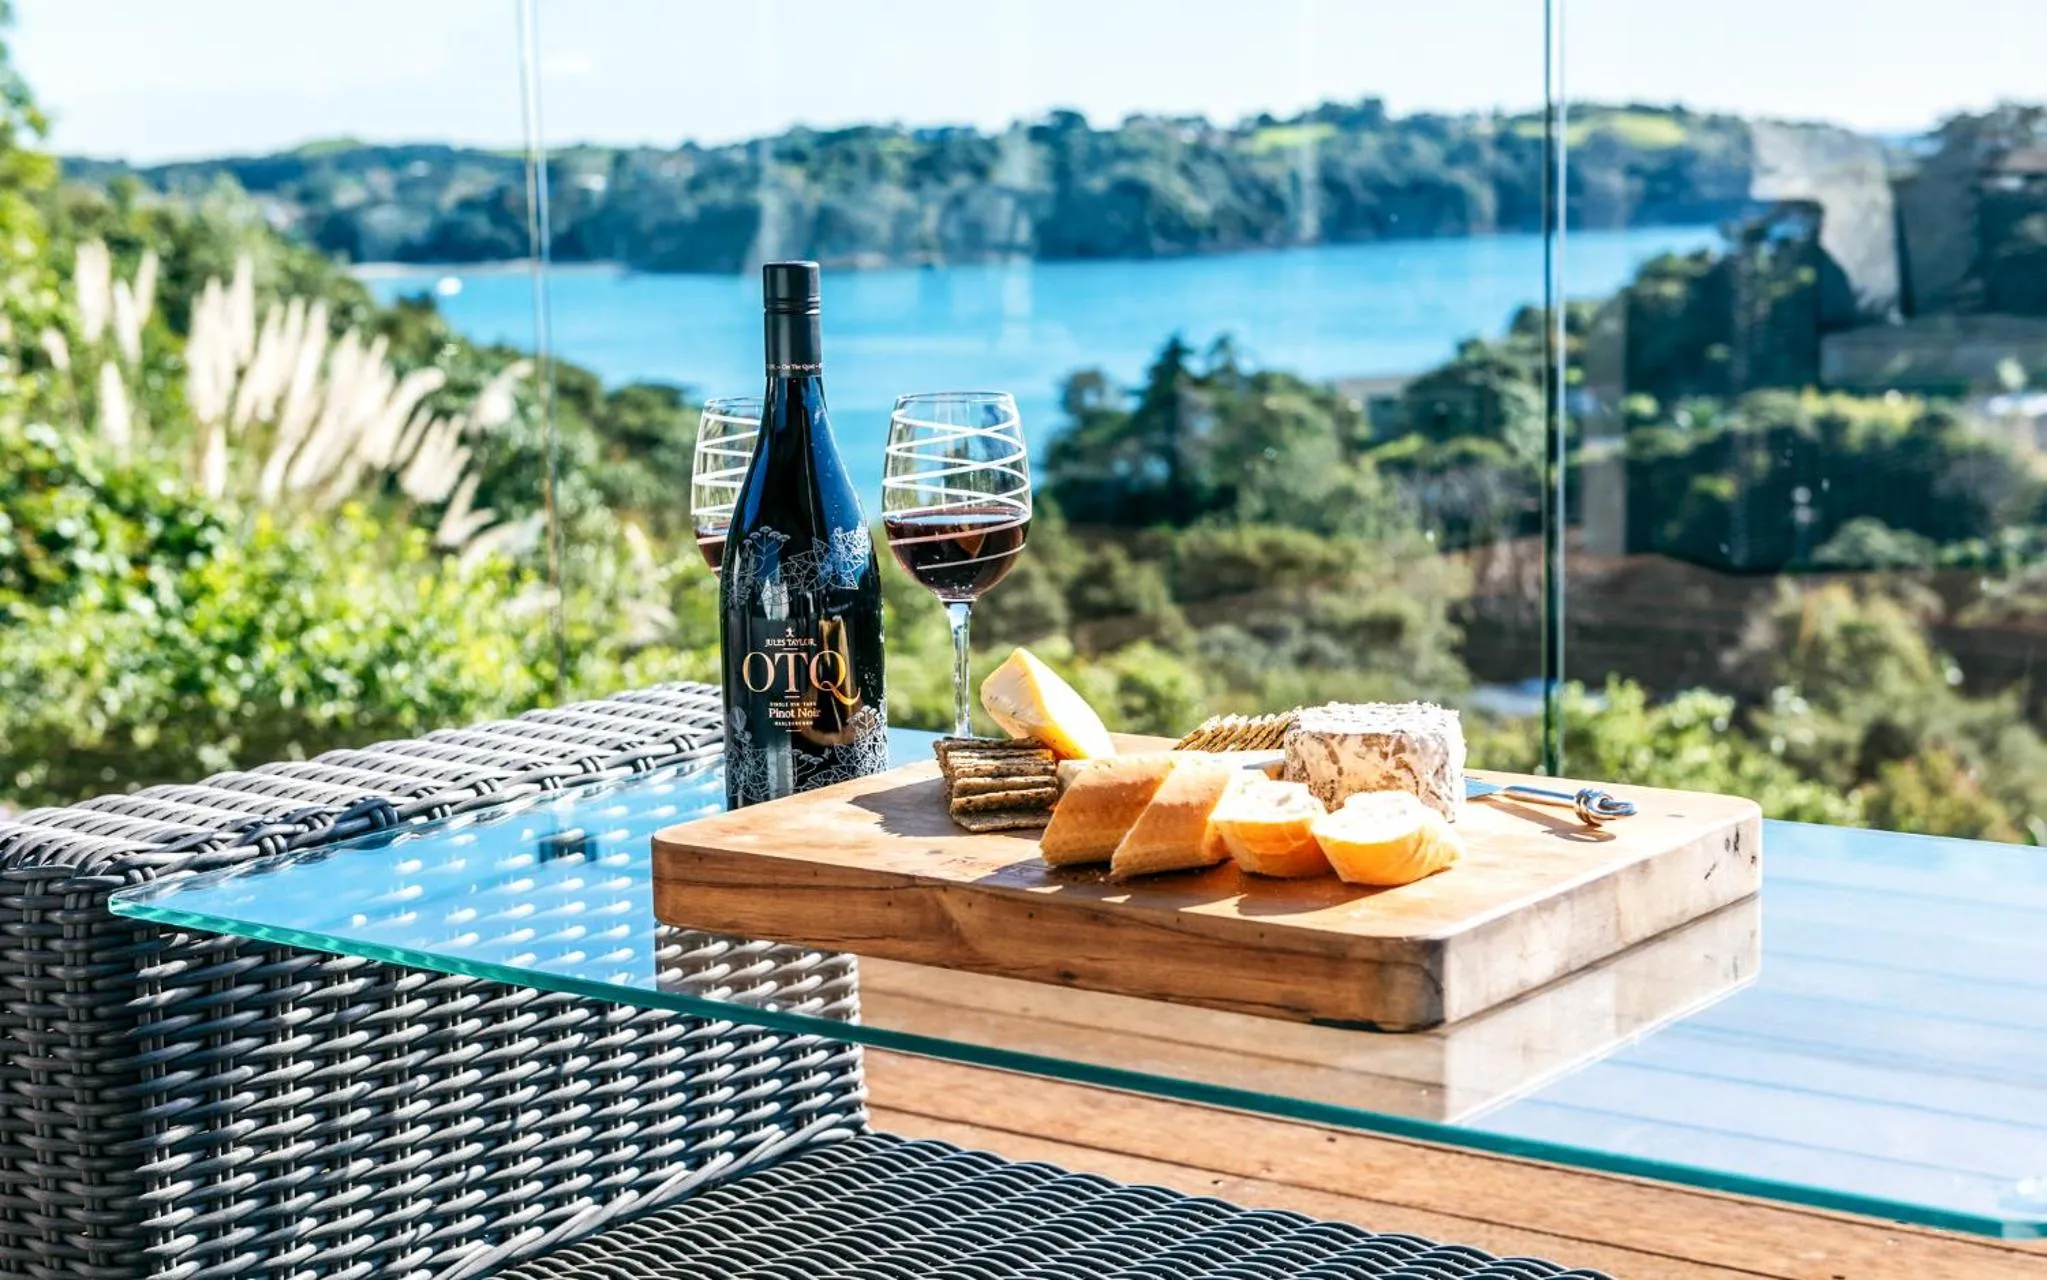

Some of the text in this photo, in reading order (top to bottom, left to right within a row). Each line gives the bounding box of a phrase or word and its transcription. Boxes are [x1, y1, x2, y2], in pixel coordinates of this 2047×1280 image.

[765, 638, 817, 647] JULES TAYLOR
[742, 650, 861, 705] OTQ
[768, 708, 821, 718] Pinot Noir
